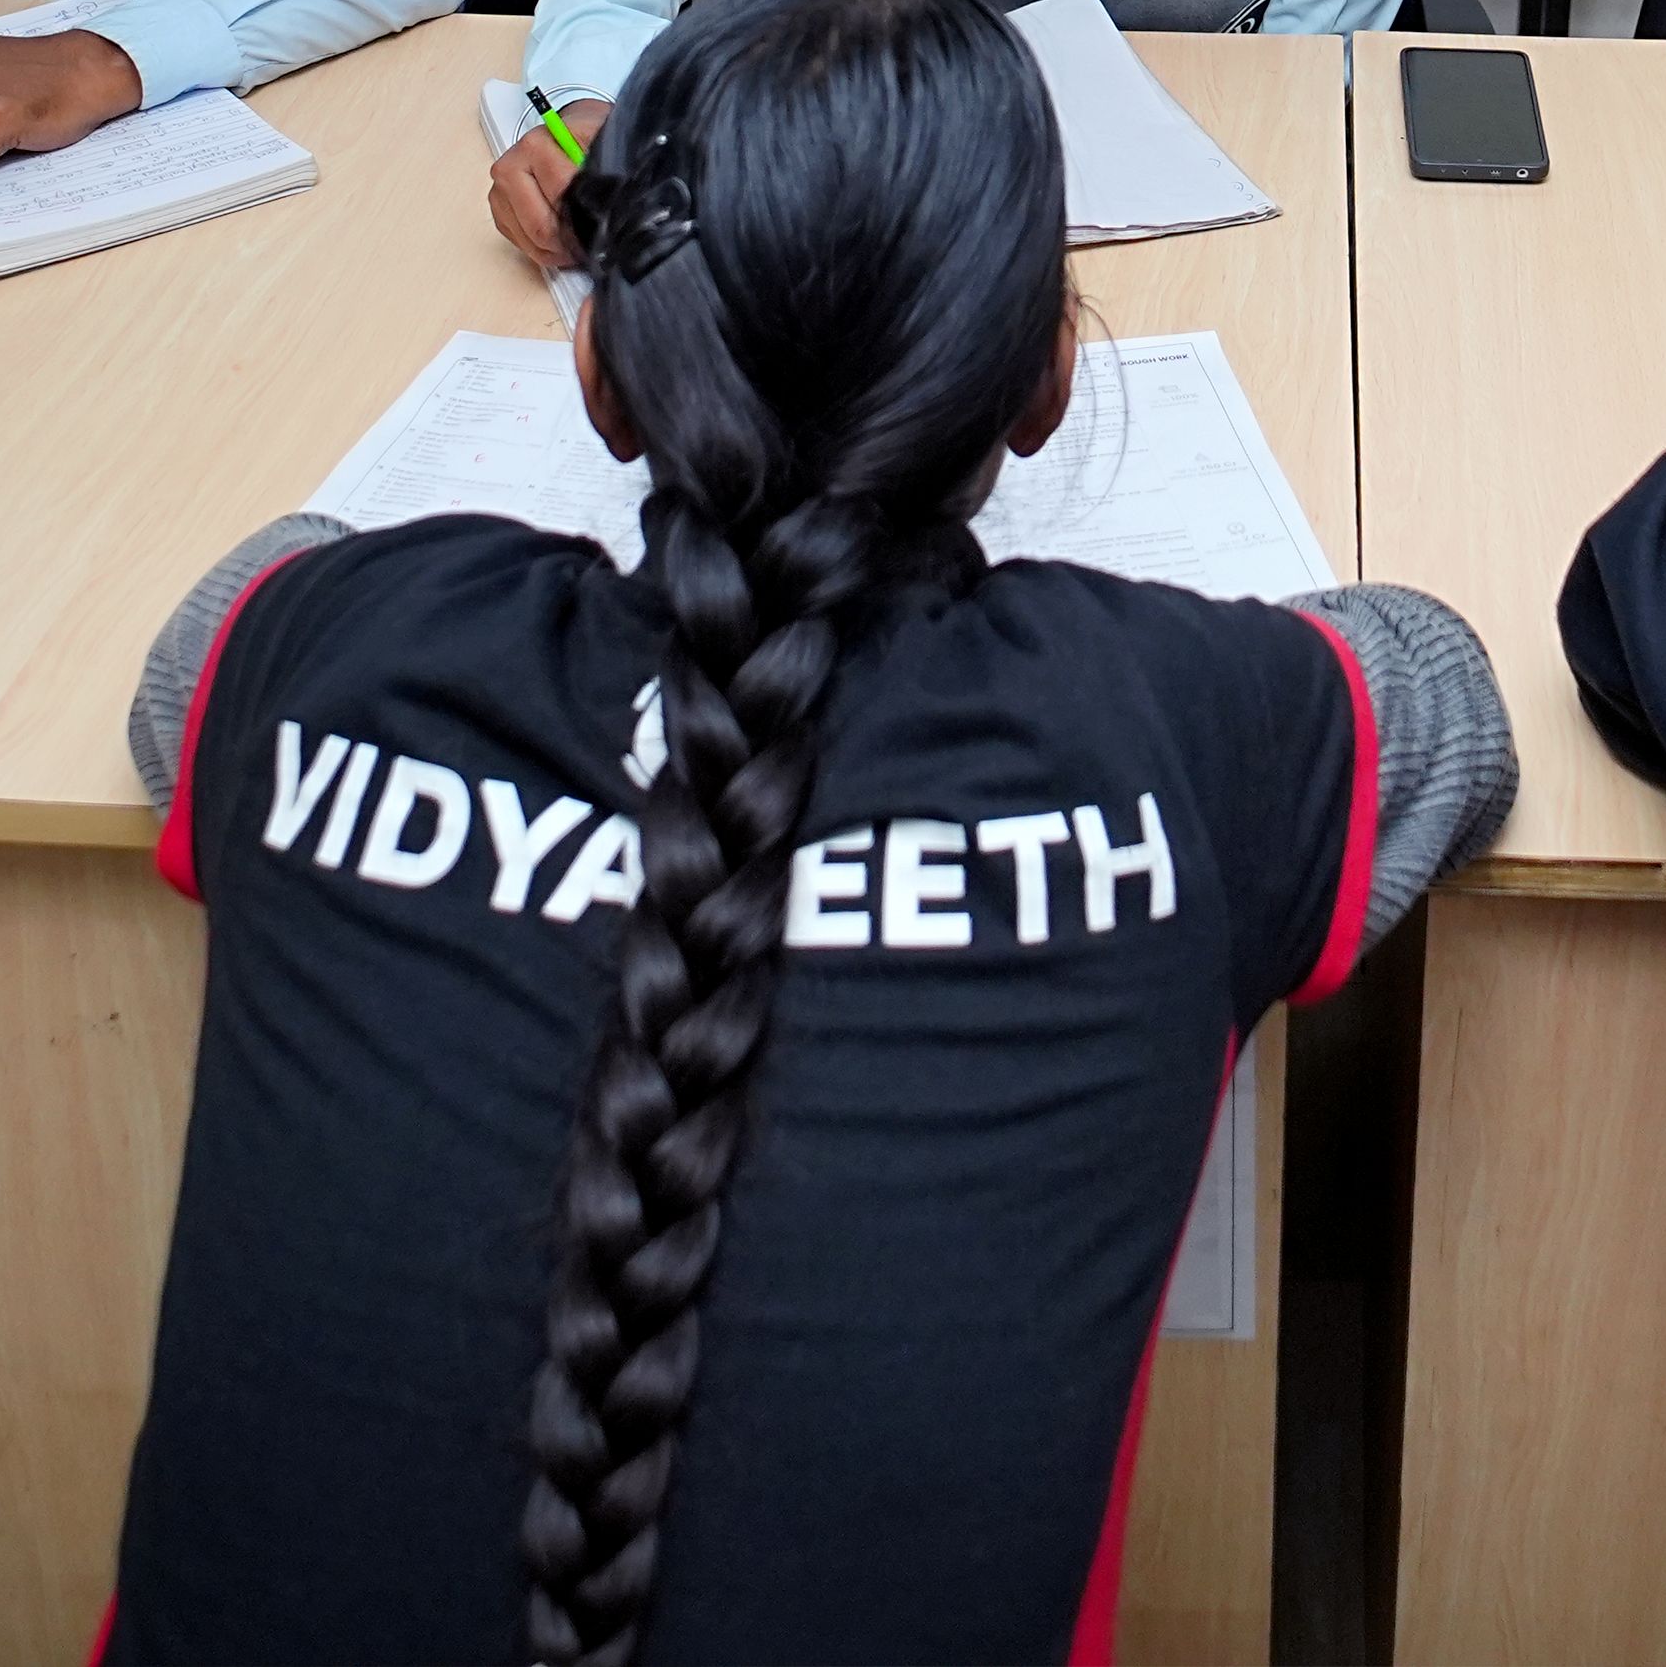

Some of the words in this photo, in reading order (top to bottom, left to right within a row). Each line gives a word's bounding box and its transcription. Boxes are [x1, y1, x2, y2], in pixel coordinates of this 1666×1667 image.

[1120, 358, 1156, 366] ROUGH
[1159, 354, 1190, 362] WORK
[262, 722, 1176, 948] VIDYAEETH
